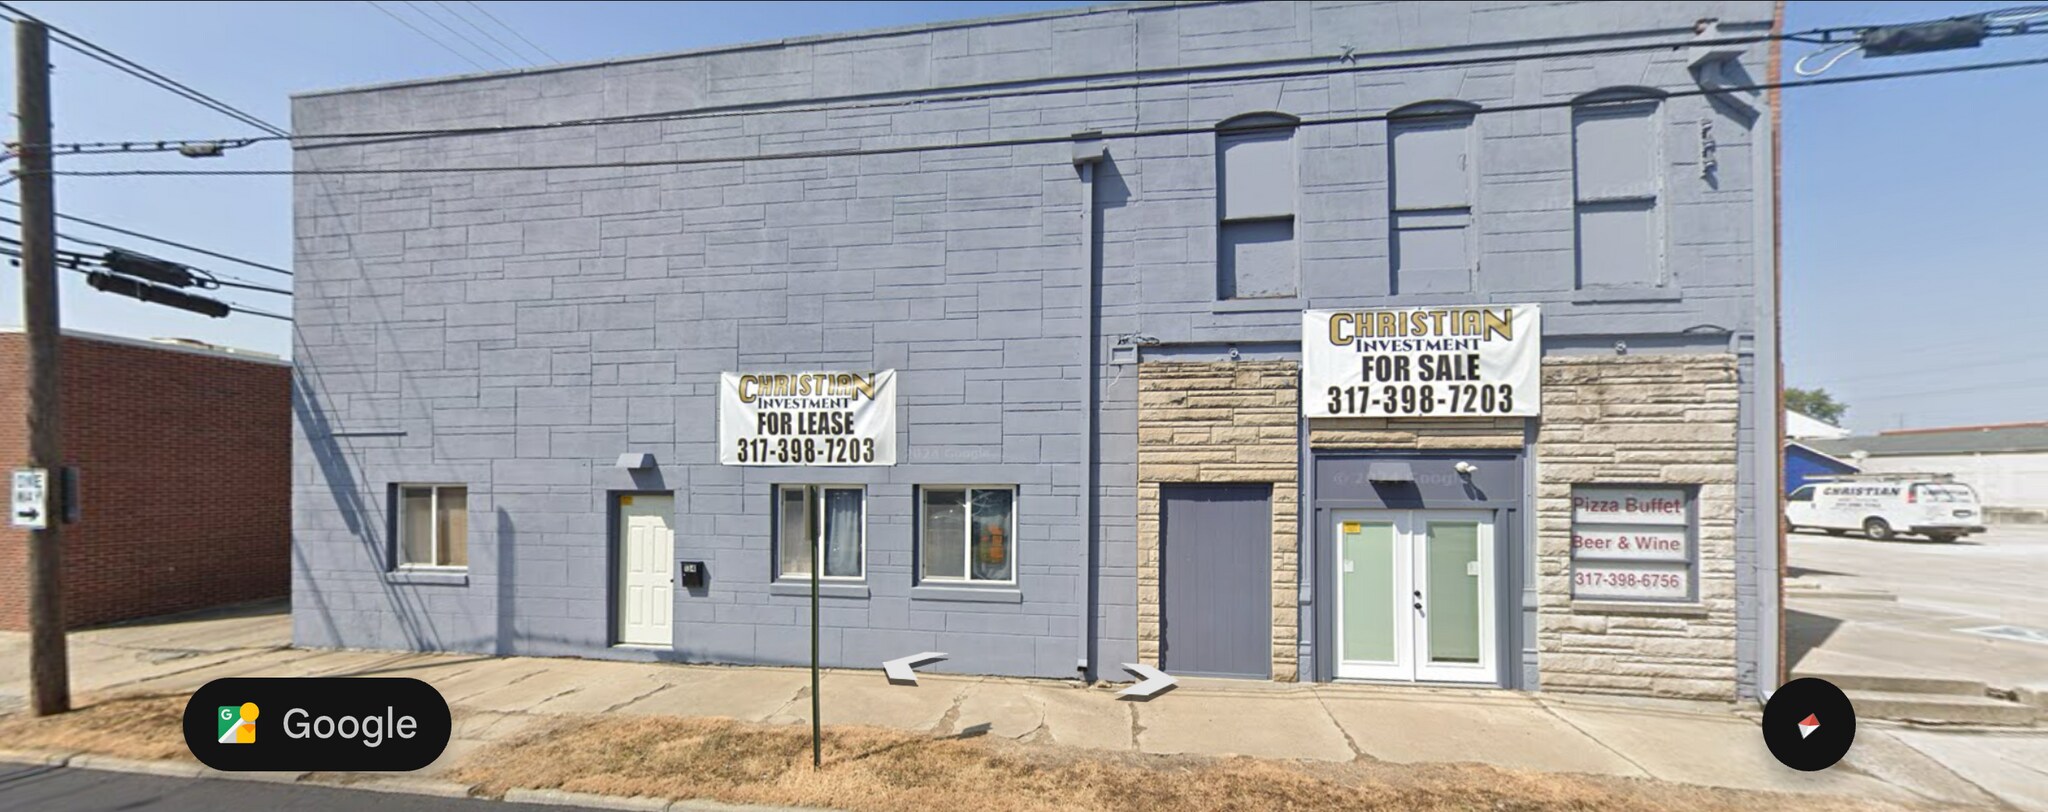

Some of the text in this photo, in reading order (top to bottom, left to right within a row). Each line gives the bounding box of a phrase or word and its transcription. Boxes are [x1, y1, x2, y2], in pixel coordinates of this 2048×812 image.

[1329, 308, 1513, 346] CHRISTIAN
[1356, 337, 1482, 352] INVESTMENT
[1362, 353, 1480, 382] FOR SALE
[738, 372, 876, 403] CHRISTIAN
[1327, 384, 1513, 414] 317-398-7203
[758, 397, 850, 409] INVESTMENT
[757, 411, 855, 435] FOR LEASE
[737, 437, 875, 464] 317-398-7203
[1573, 497, 1681, 513] Pizza Buffet
[1572, 535, 1680, 550] Beer & Wine
[1575, 572, 1680, 588] 317-398-6756
